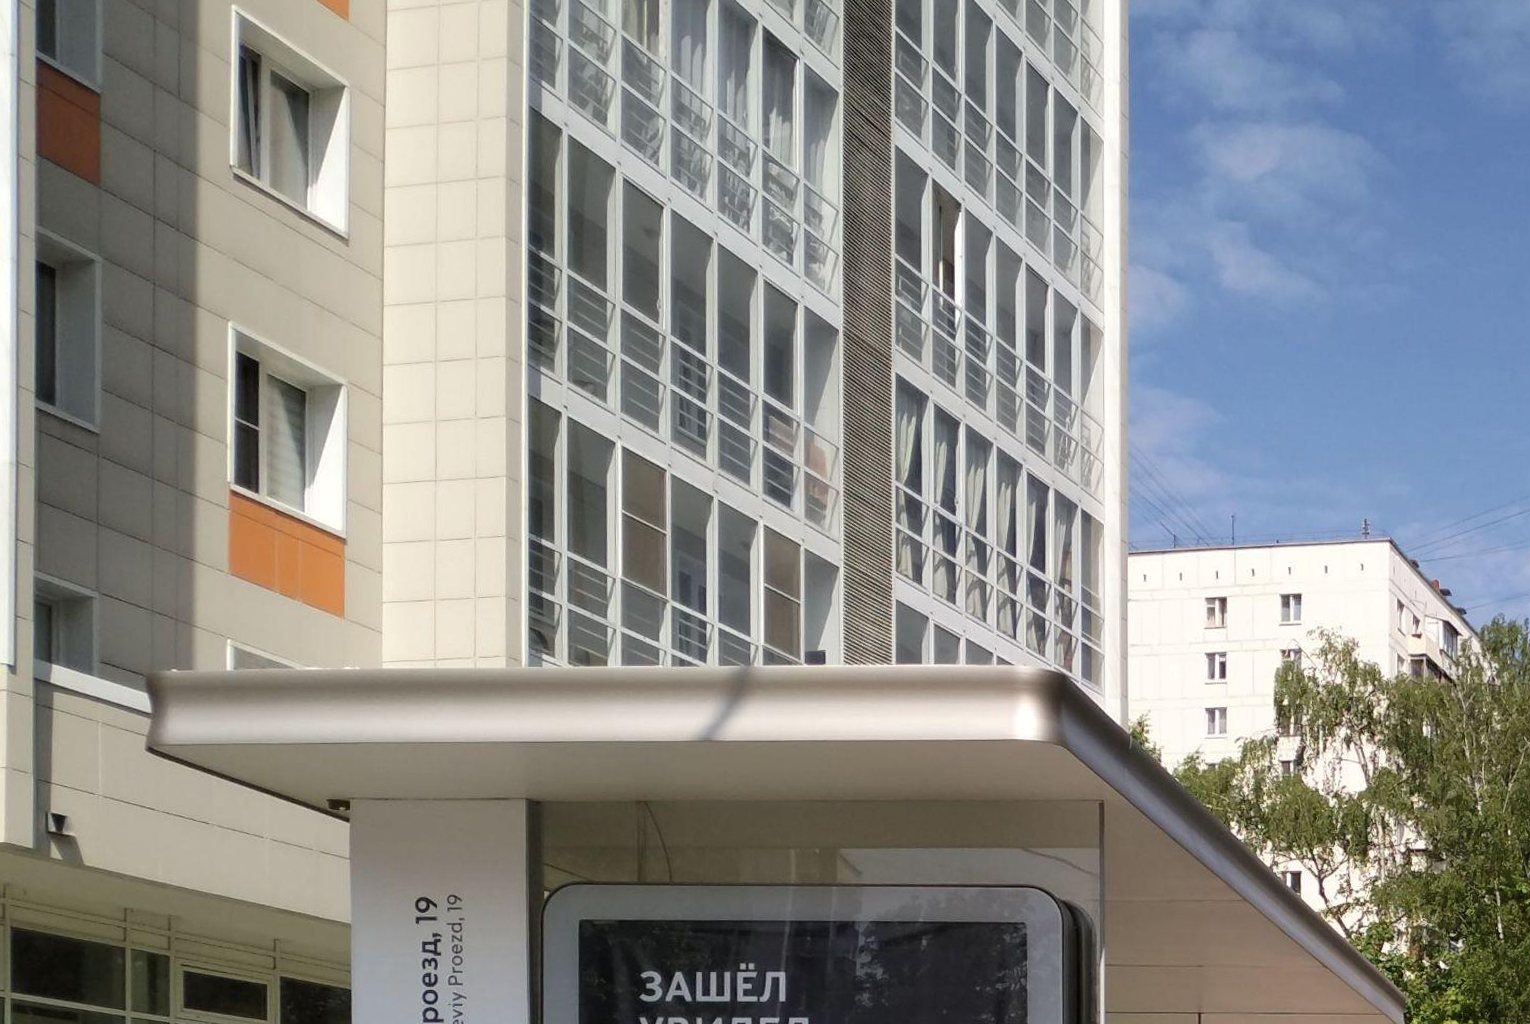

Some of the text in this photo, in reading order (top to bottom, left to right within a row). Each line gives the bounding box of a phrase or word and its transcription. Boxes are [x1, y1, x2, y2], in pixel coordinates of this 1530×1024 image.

[414, 896, 438, 925] 19
[446, 894, 463, 912] 19
[446, 917, 466, 986] Proezd,
[639, 963, 787, 1003] ЗАШЁЛ
